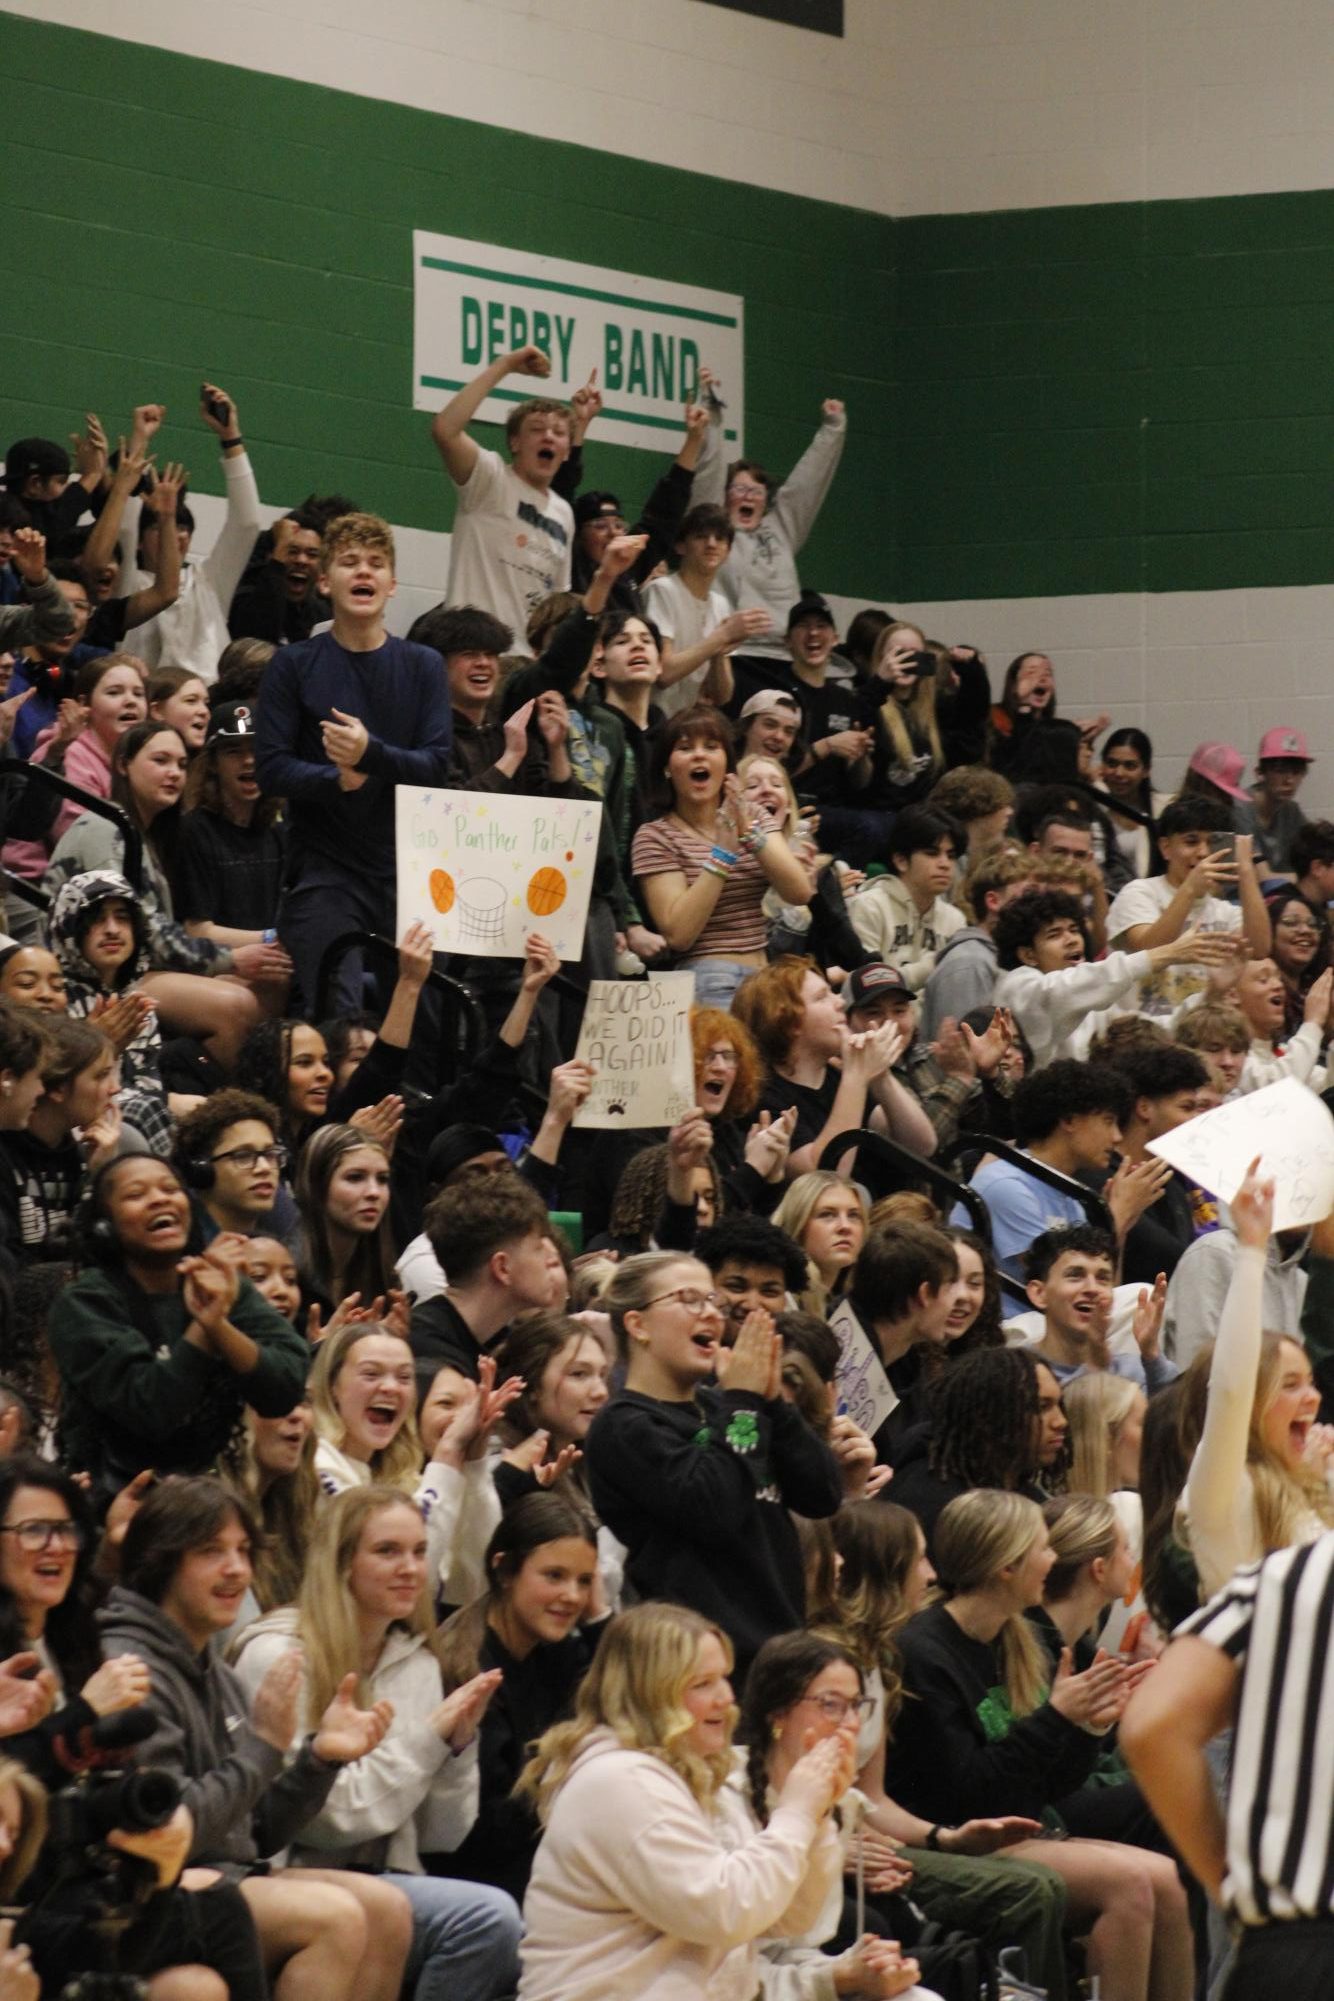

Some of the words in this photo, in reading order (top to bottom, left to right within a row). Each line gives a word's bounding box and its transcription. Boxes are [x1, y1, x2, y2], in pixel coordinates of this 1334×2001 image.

[461, 295, 575, 383] DERBY
[605, 323, 700, 404] BAND
[454, 814, 519, 853] Panther
[582, 1017, 617, 1040] WE
[627, 1015, 666, 1042] DID
[672, 1010, 687, 1035] IT
[588, 1040, 677, 1071] AGAIN!
